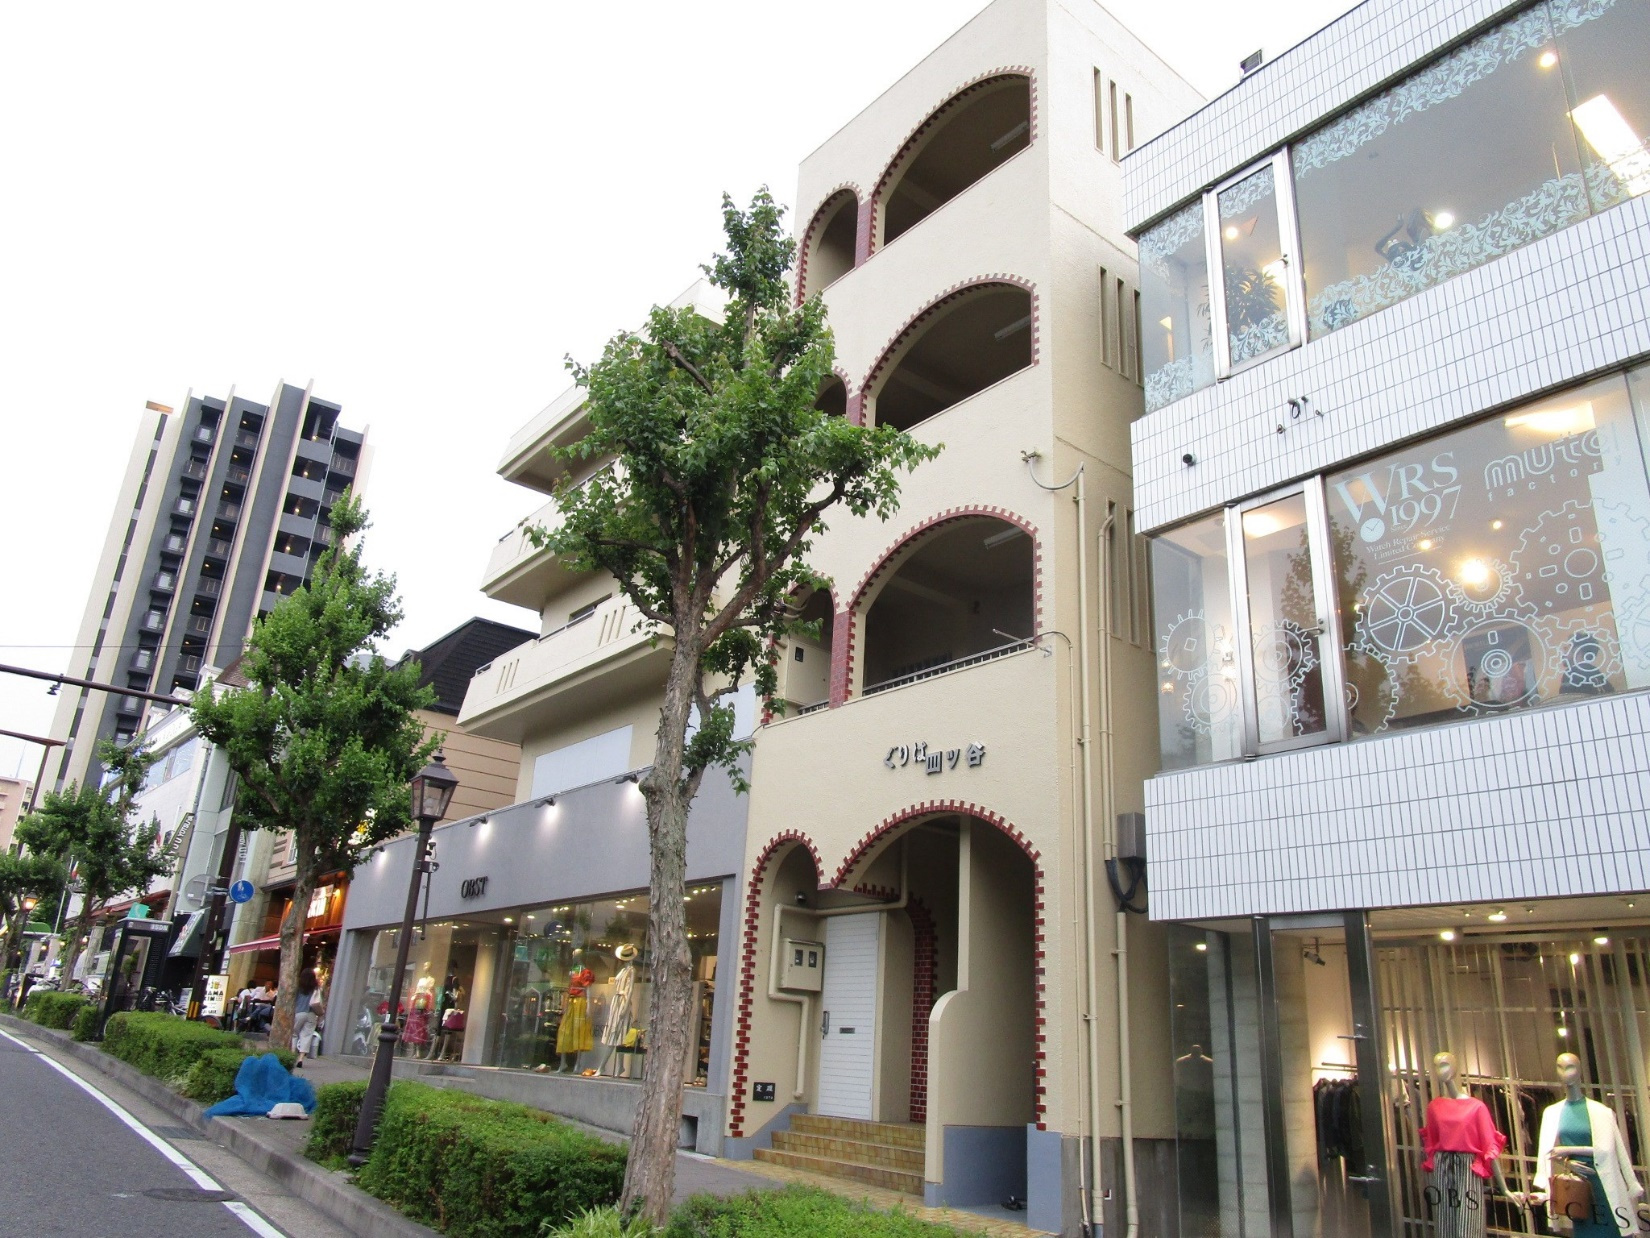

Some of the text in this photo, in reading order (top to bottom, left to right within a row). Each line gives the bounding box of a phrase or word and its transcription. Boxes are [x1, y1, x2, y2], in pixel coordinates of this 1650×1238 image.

[1333, 451, 1458, 524] WRS
[1389, 484, 1462, 534] 1997
[1366, 541, 1391, 554] Watch
[1393, 534, 1418, 547] Repair
[1374, 546, 1408, 560] Limited
[461, 876, 489, 899] OBST
